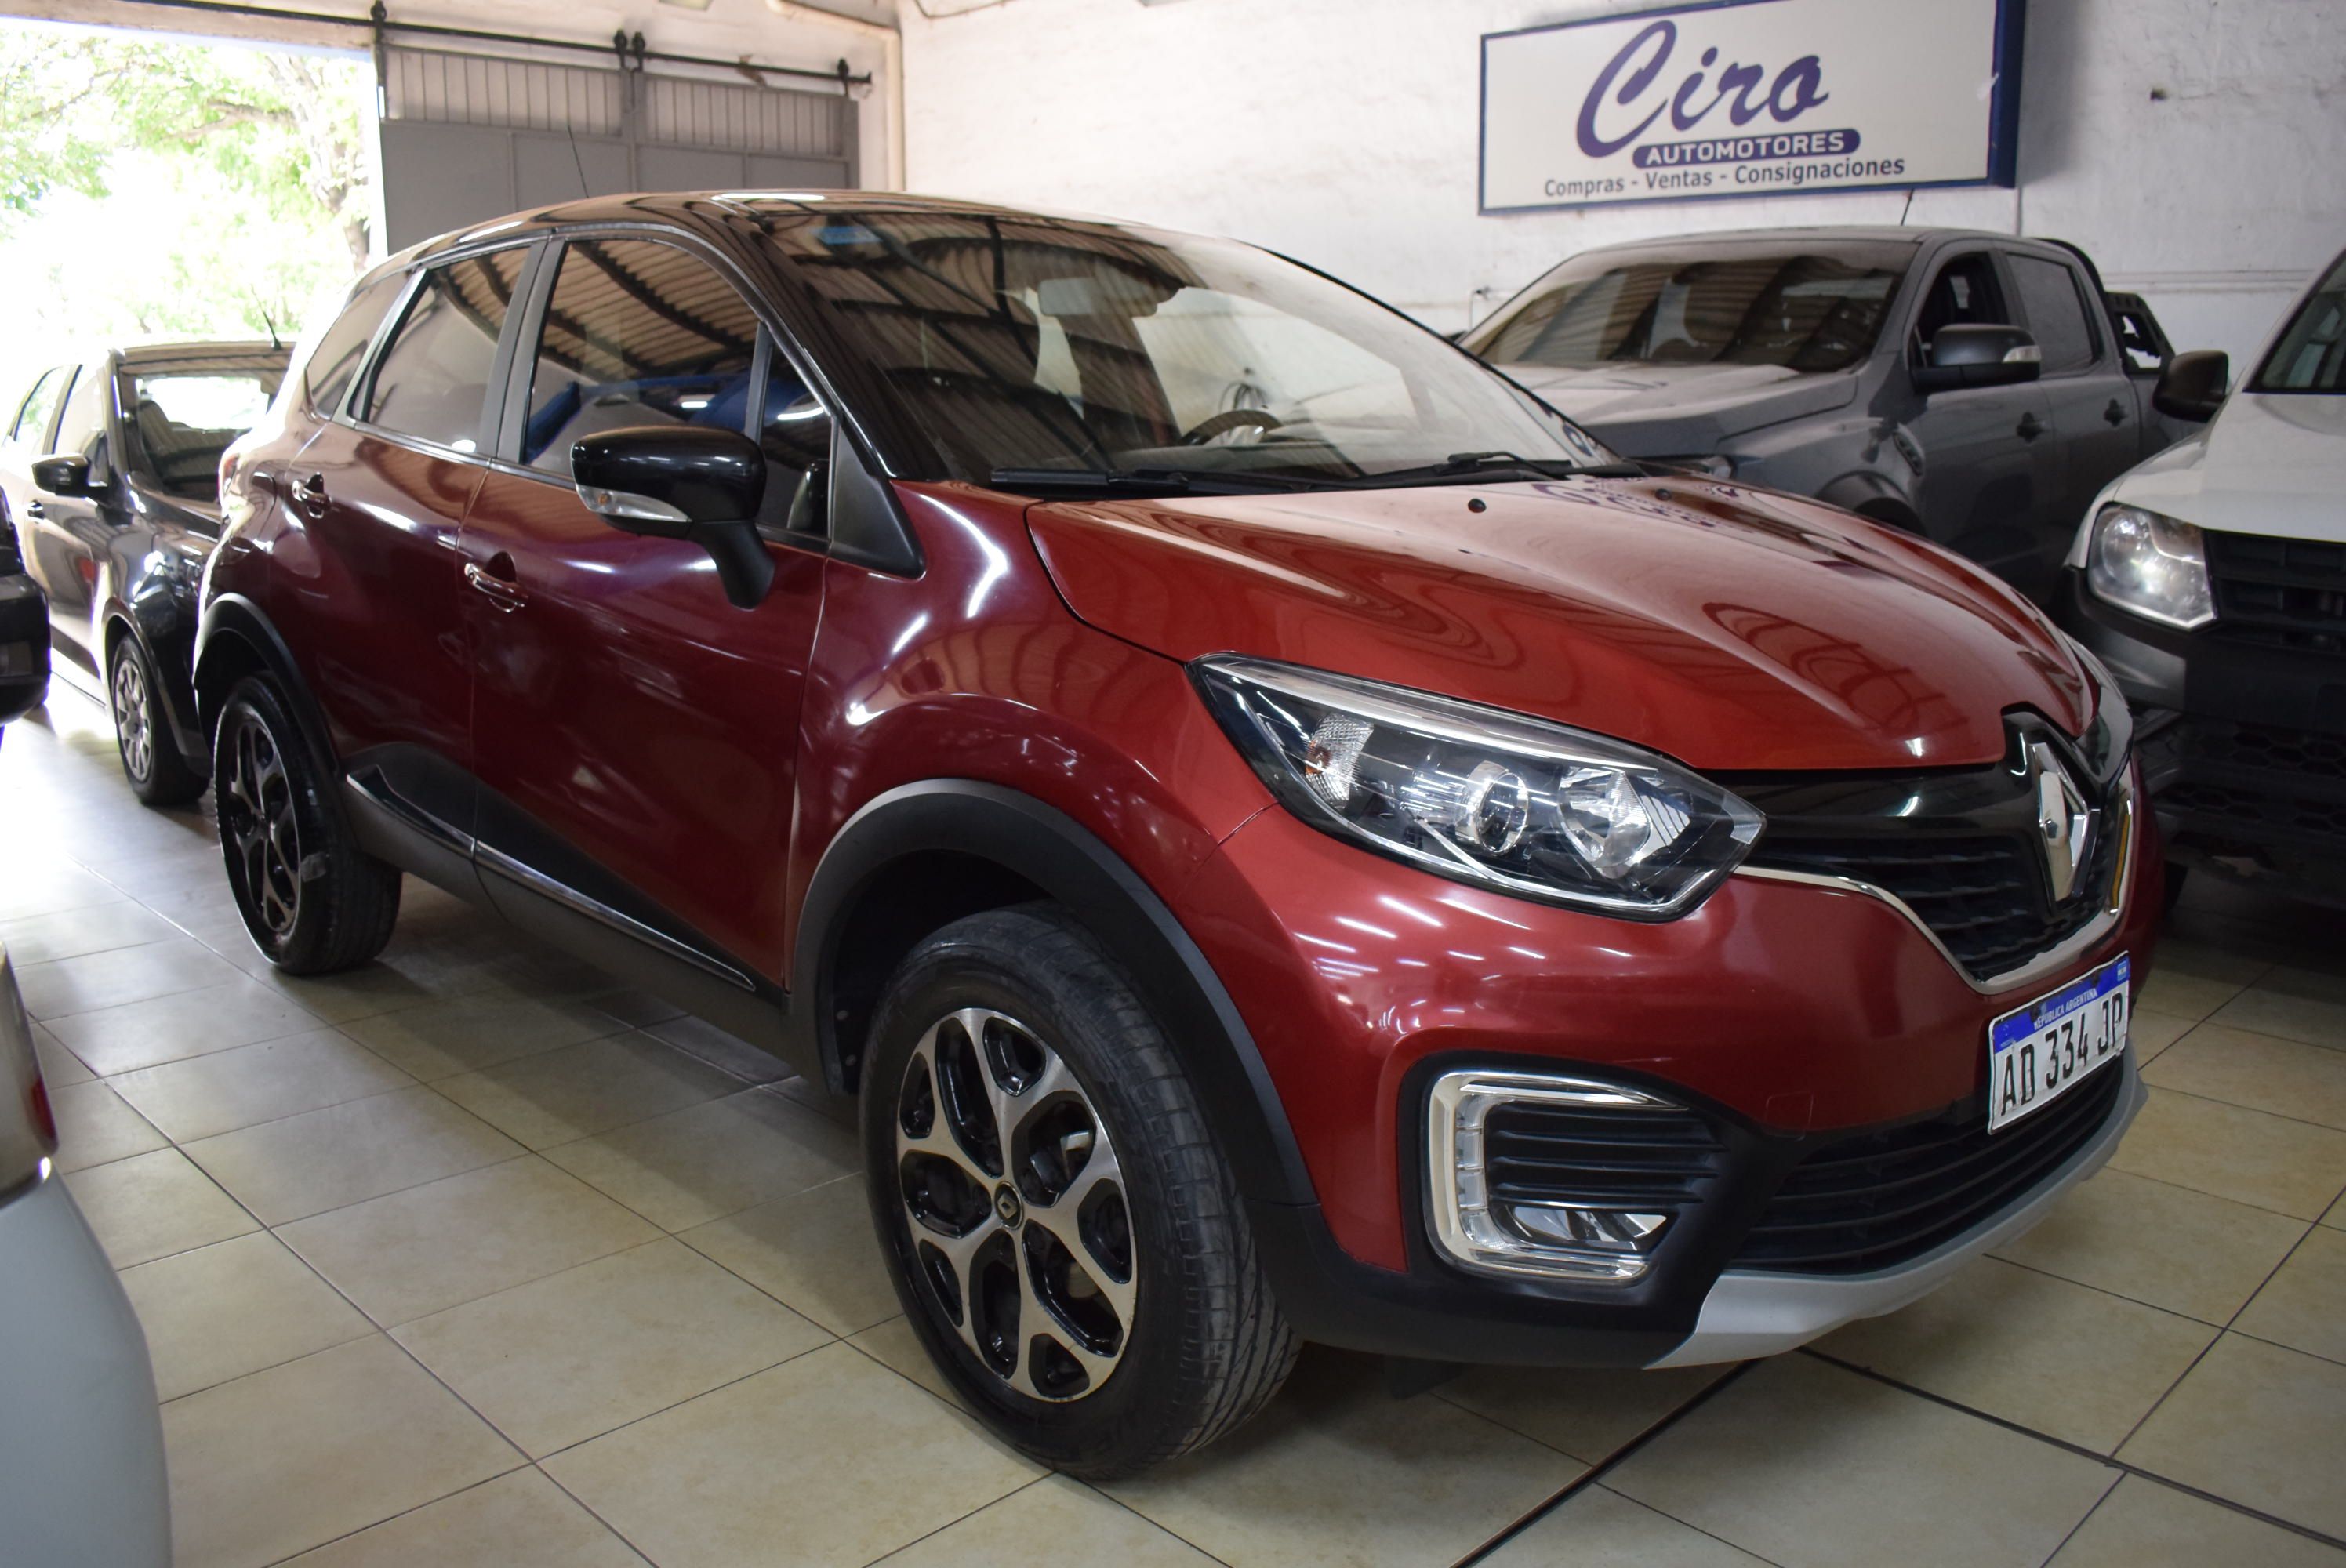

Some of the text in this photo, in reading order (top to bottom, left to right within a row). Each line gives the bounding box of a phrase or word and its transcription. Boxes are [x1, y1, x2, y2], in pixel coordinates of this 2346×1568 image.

[1576, 20, 1829, 158] Ciro
[1645, 131, 1845, 165] AUTOMOTORES
[1544, 178, 1625, 198] Compras
[1646, 170, 1712, 190] Ventas
[1734, 157, 1905, 185] Consignaciones
[2065, 988, 2098, 1012] ARGENTINA
[2000, 993, 2123, 1116] AD 334 JP
